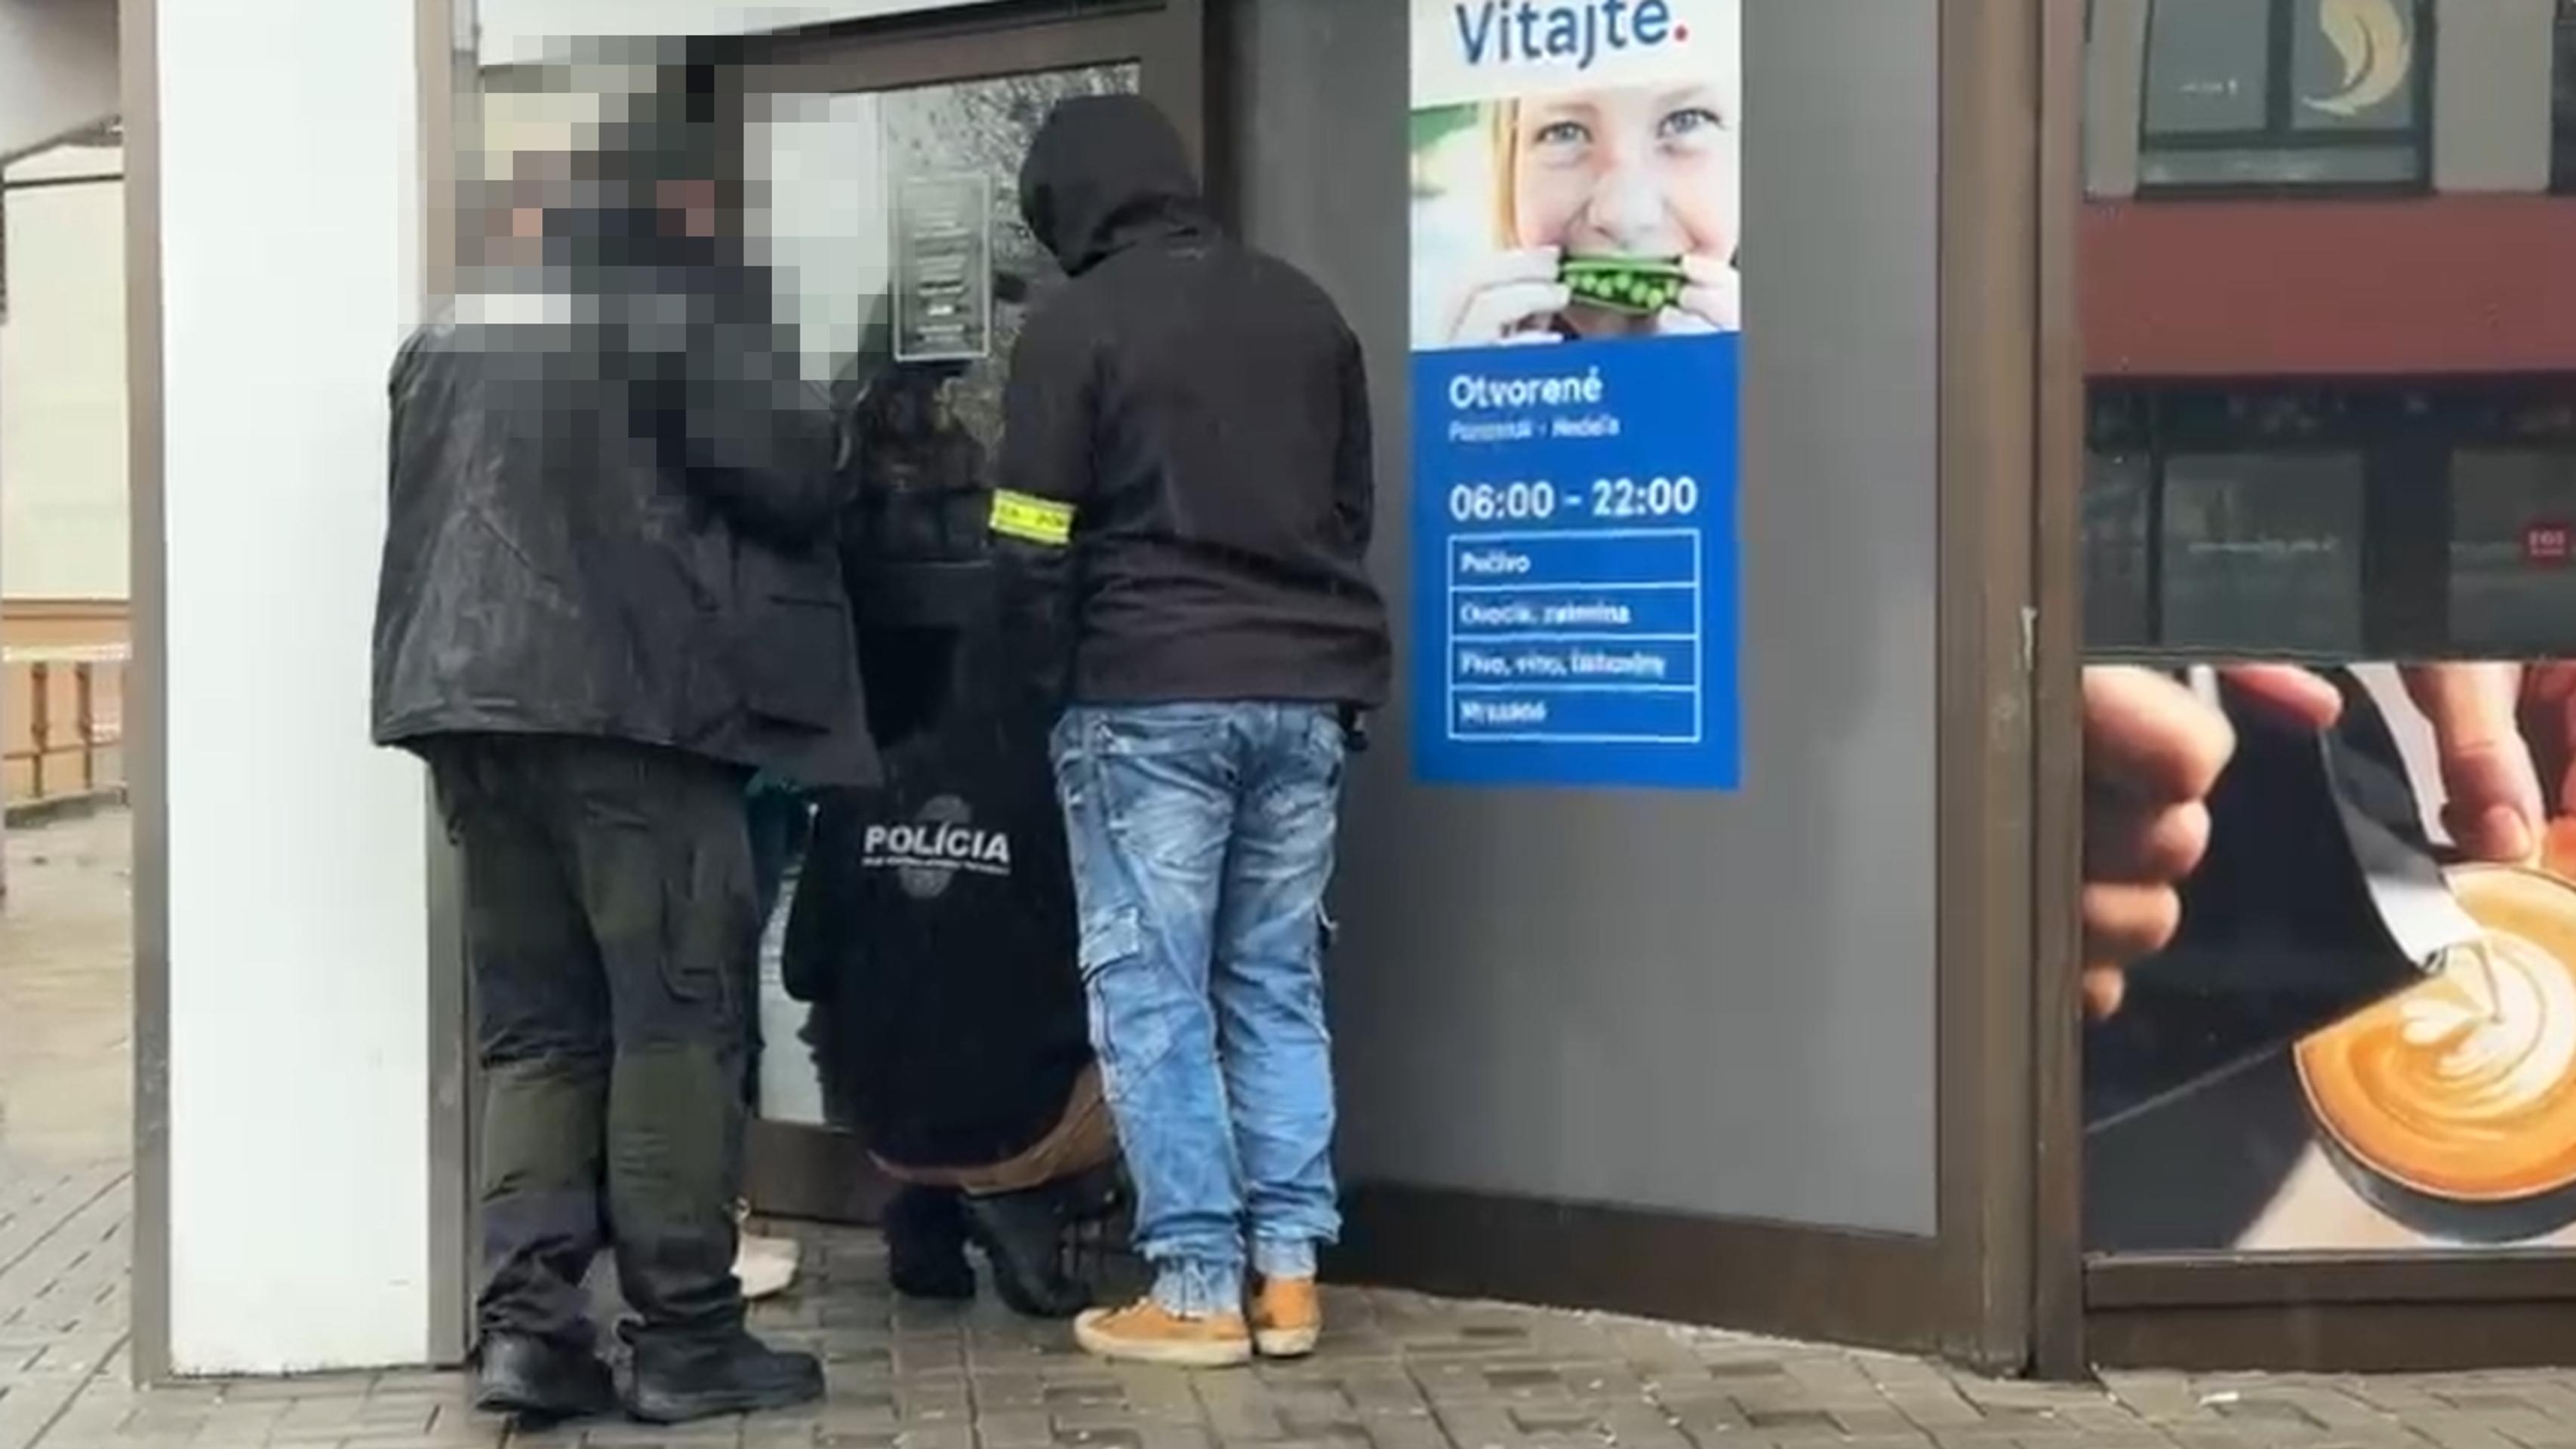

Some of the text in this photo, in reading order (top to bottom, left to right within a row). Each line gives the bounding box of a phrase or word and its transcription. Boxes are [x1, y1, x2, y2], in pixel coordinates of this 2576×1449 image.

[1456, 0, 1688, 69] Vitajte.
[1449, 365, 1603, 409] Otvorené
[1449, 481, 1555, 521] 06:00
[1592, 475, 1698, 517] 22:00
[864, 820, 1011, 864] POLÍCIA
